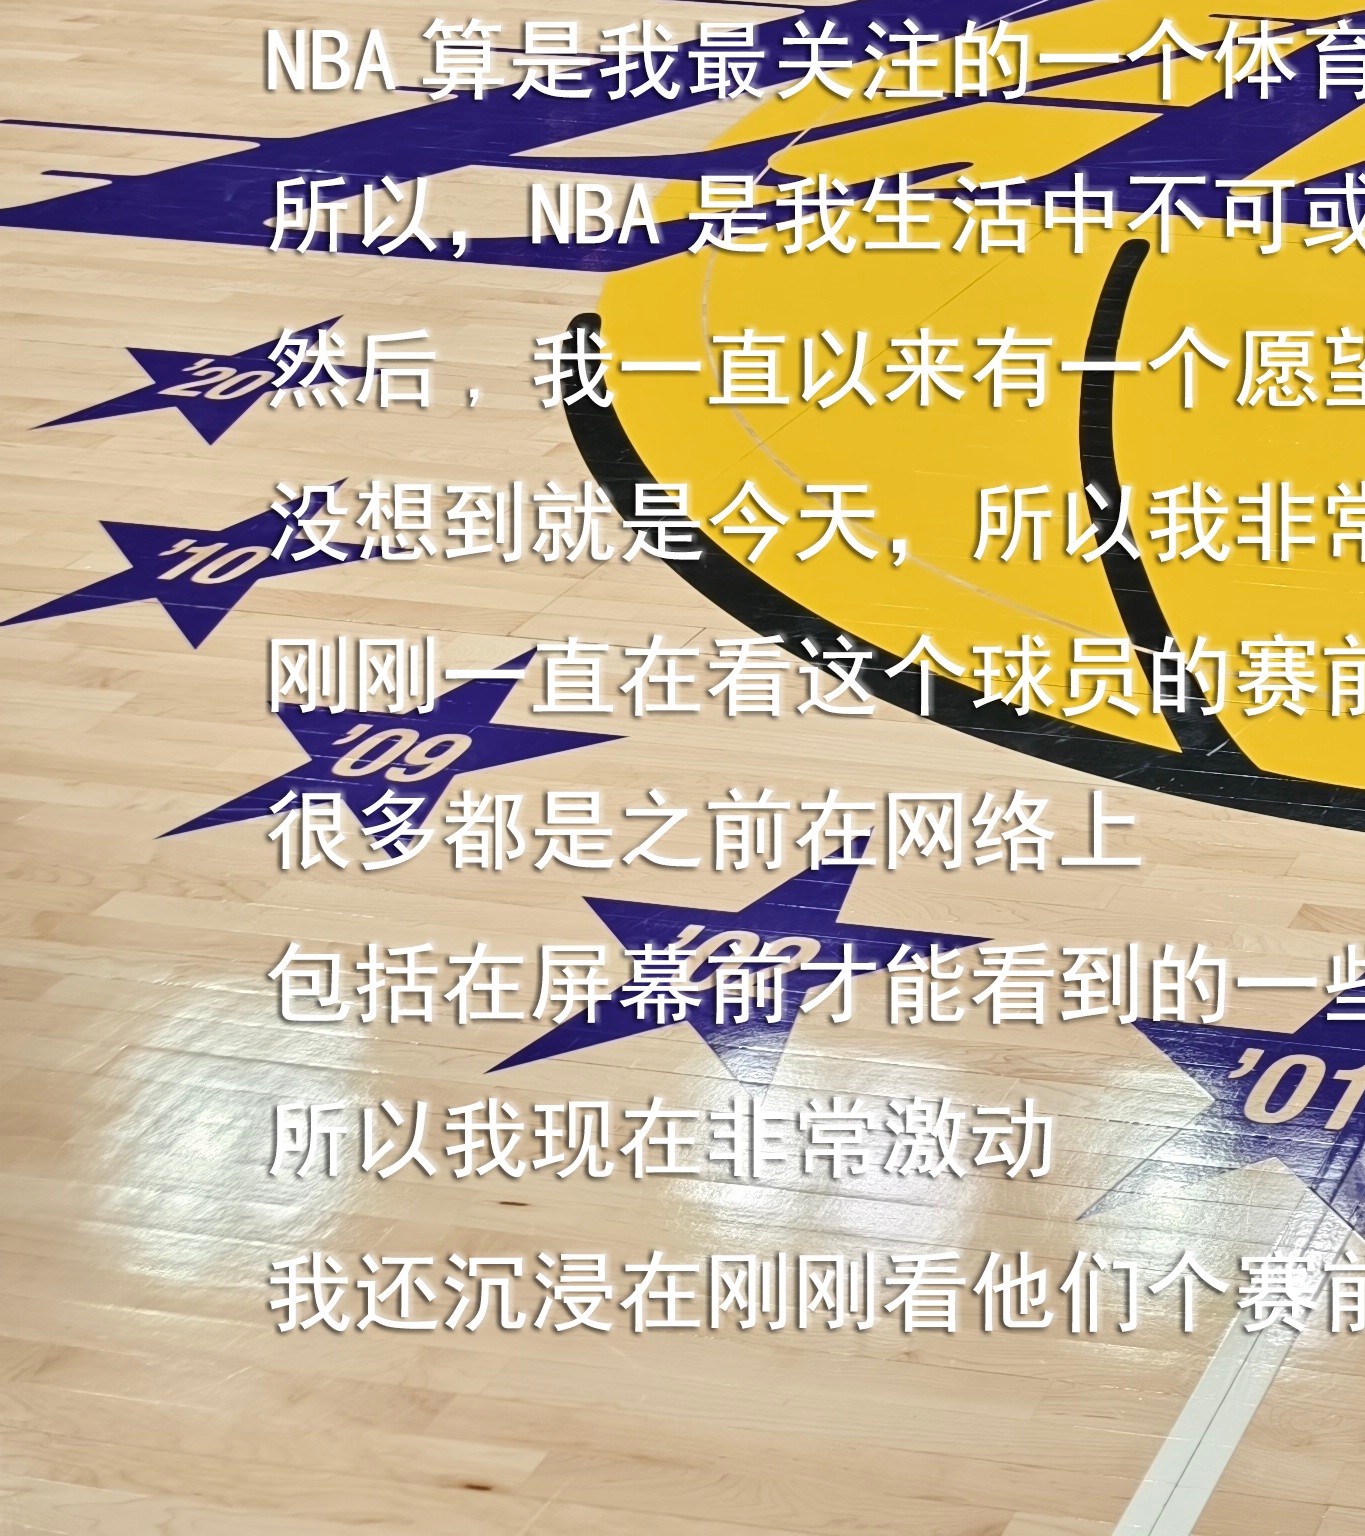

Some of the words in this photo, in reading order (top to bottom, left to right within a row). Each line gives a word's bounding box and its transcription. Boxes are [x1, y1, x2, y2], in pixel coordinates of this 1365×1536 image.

[156, 357, 276, 401] '20
[156, 537, 273, 585] '10
[332, 722, 473, 785] '09
